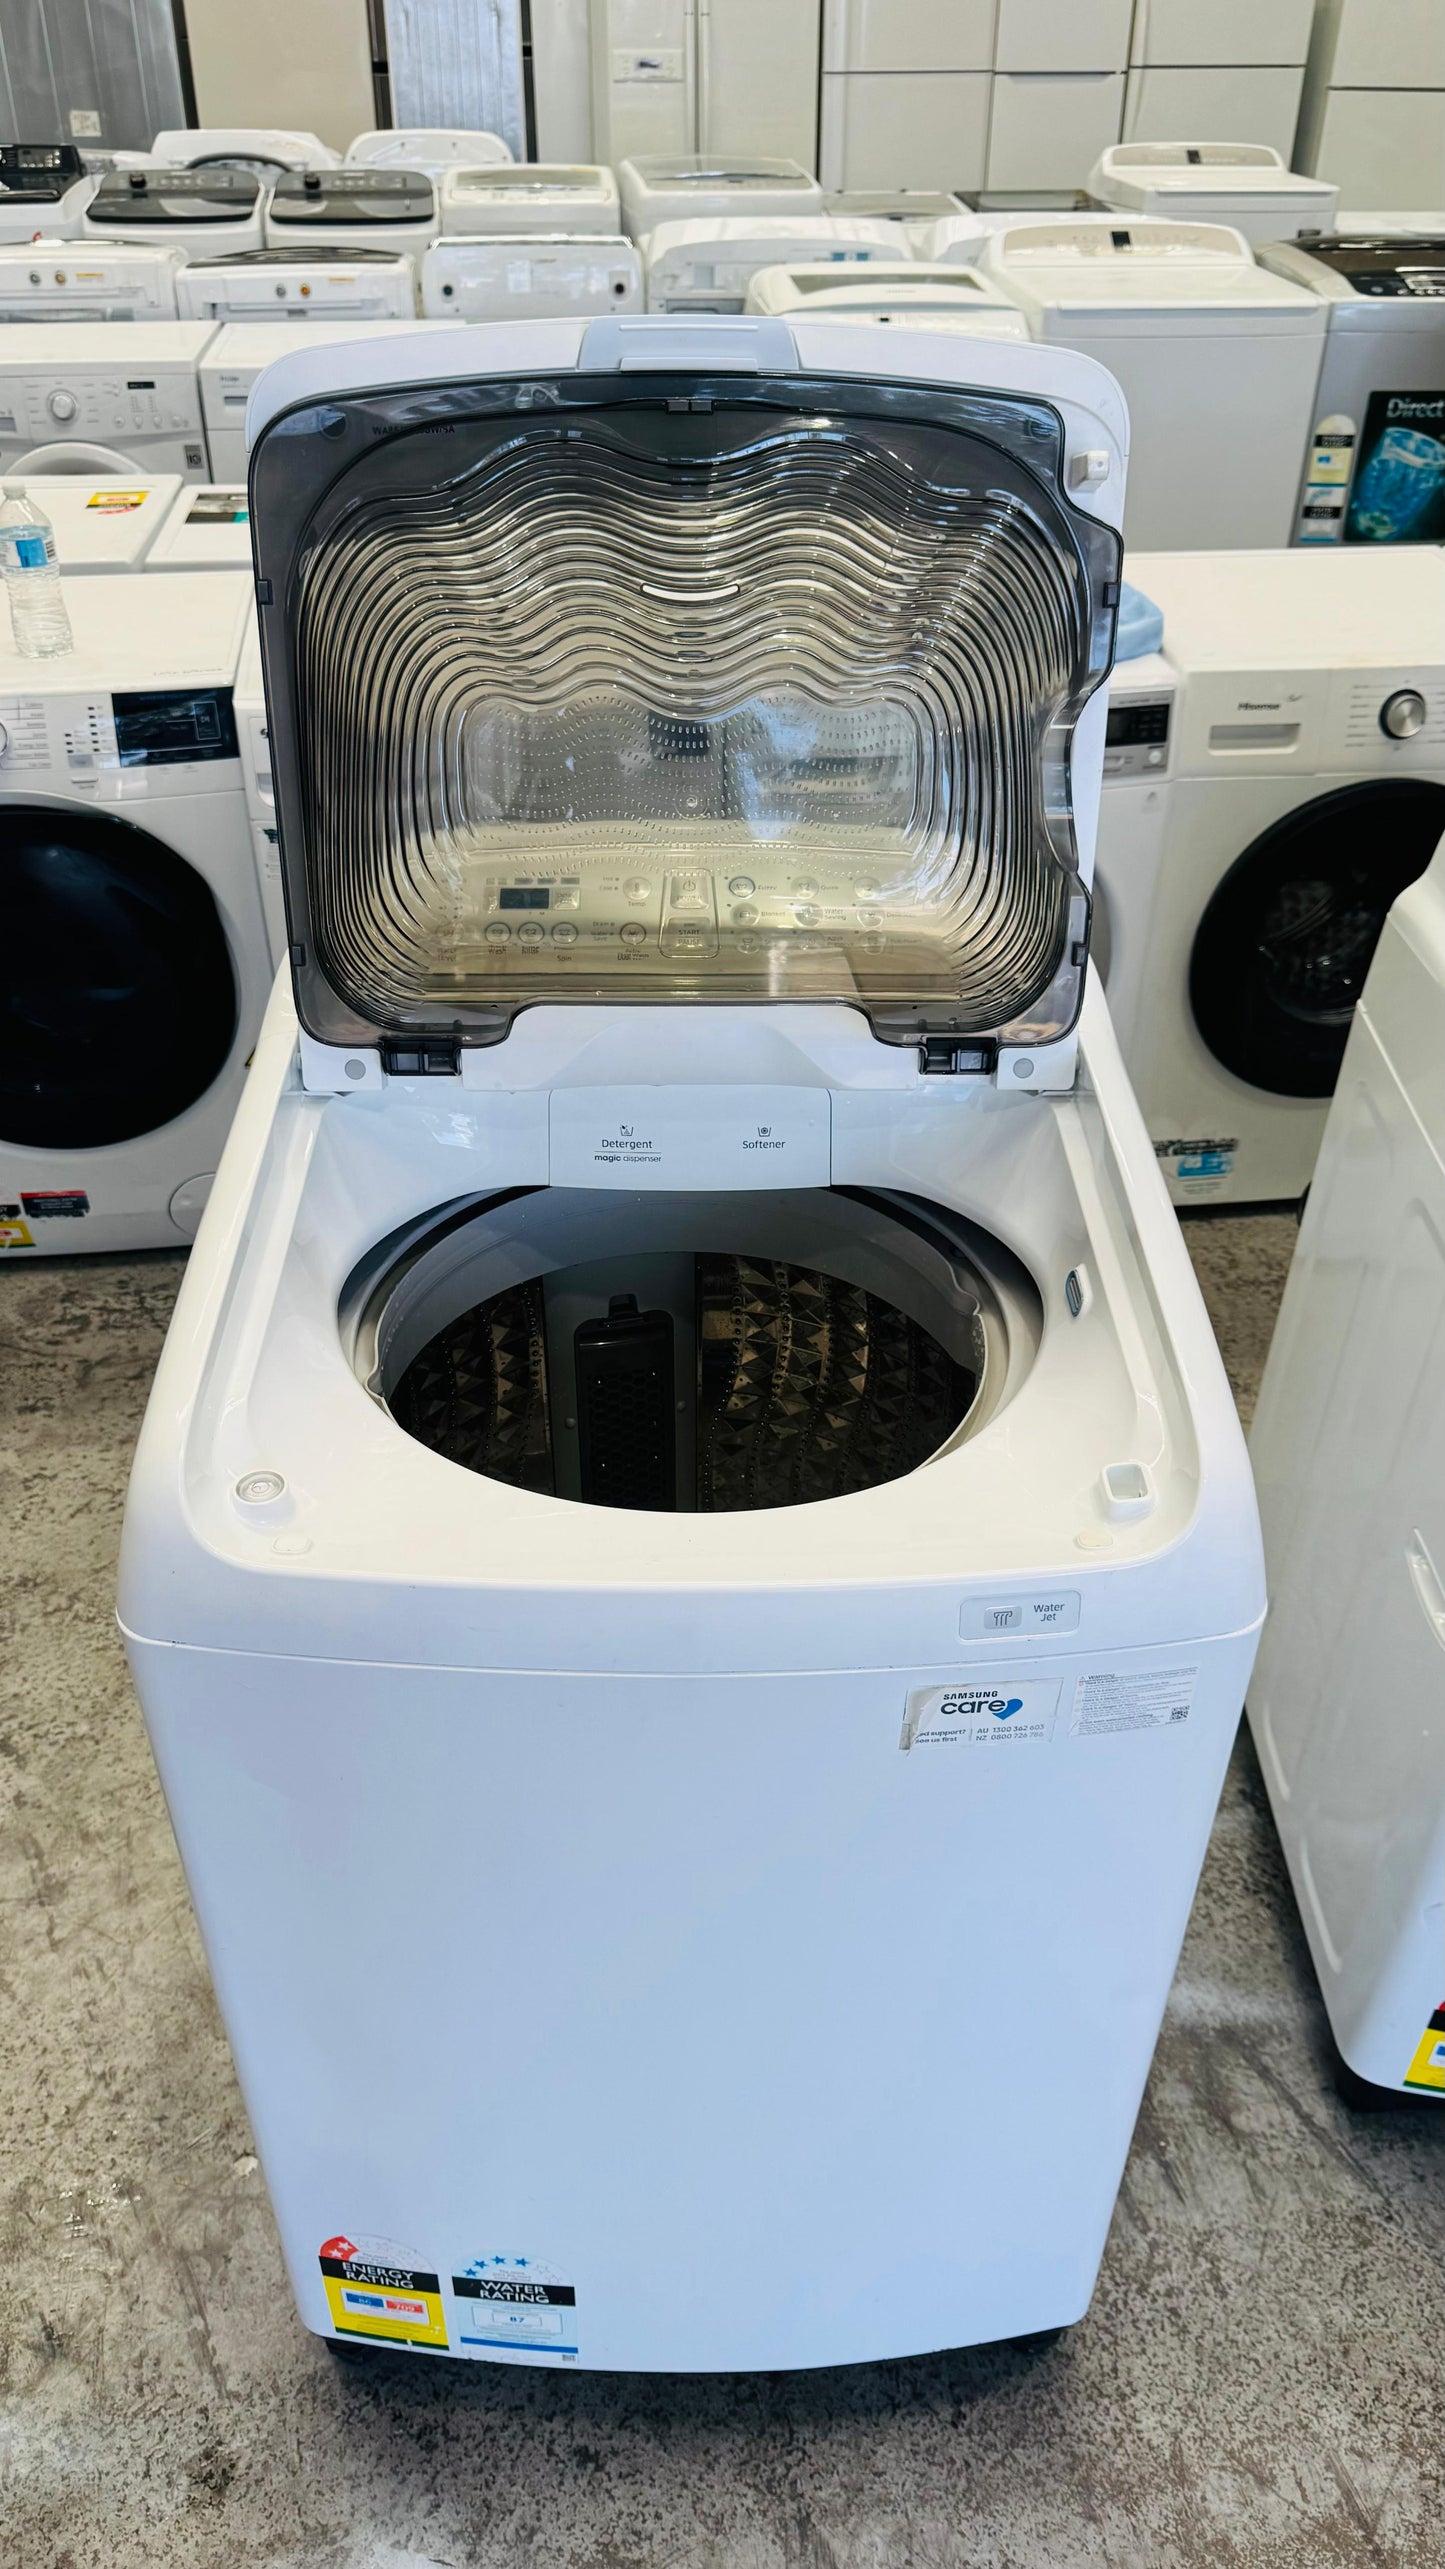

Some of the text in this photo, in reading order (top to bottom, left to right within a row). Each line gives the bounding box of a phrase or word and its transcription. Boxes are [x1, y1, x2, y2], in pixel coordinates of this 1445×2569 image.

[1238, 702, 1281, 711] Hisense
[601, 1139, 653, 1150] Detergent
[742, 1140, 786, 1149] Softener
[594, 1154, 621, 1162] magic
[1033, 1603, 1065, 1613] Water
[1040, 1613, 1056, 1621] Jet
[943, 1690, 998, 1700] SAMSUNG
[940, 1699, 1006, 1714] care
[930, 1729, 967, 1737] support?
[342, 2261, 414, 2280] ENERGY
[346, 2271, 414, 2290] RATING
[481, 2280, 546, 2295] WATER
[480, 2289, 550, 2304] RATING
